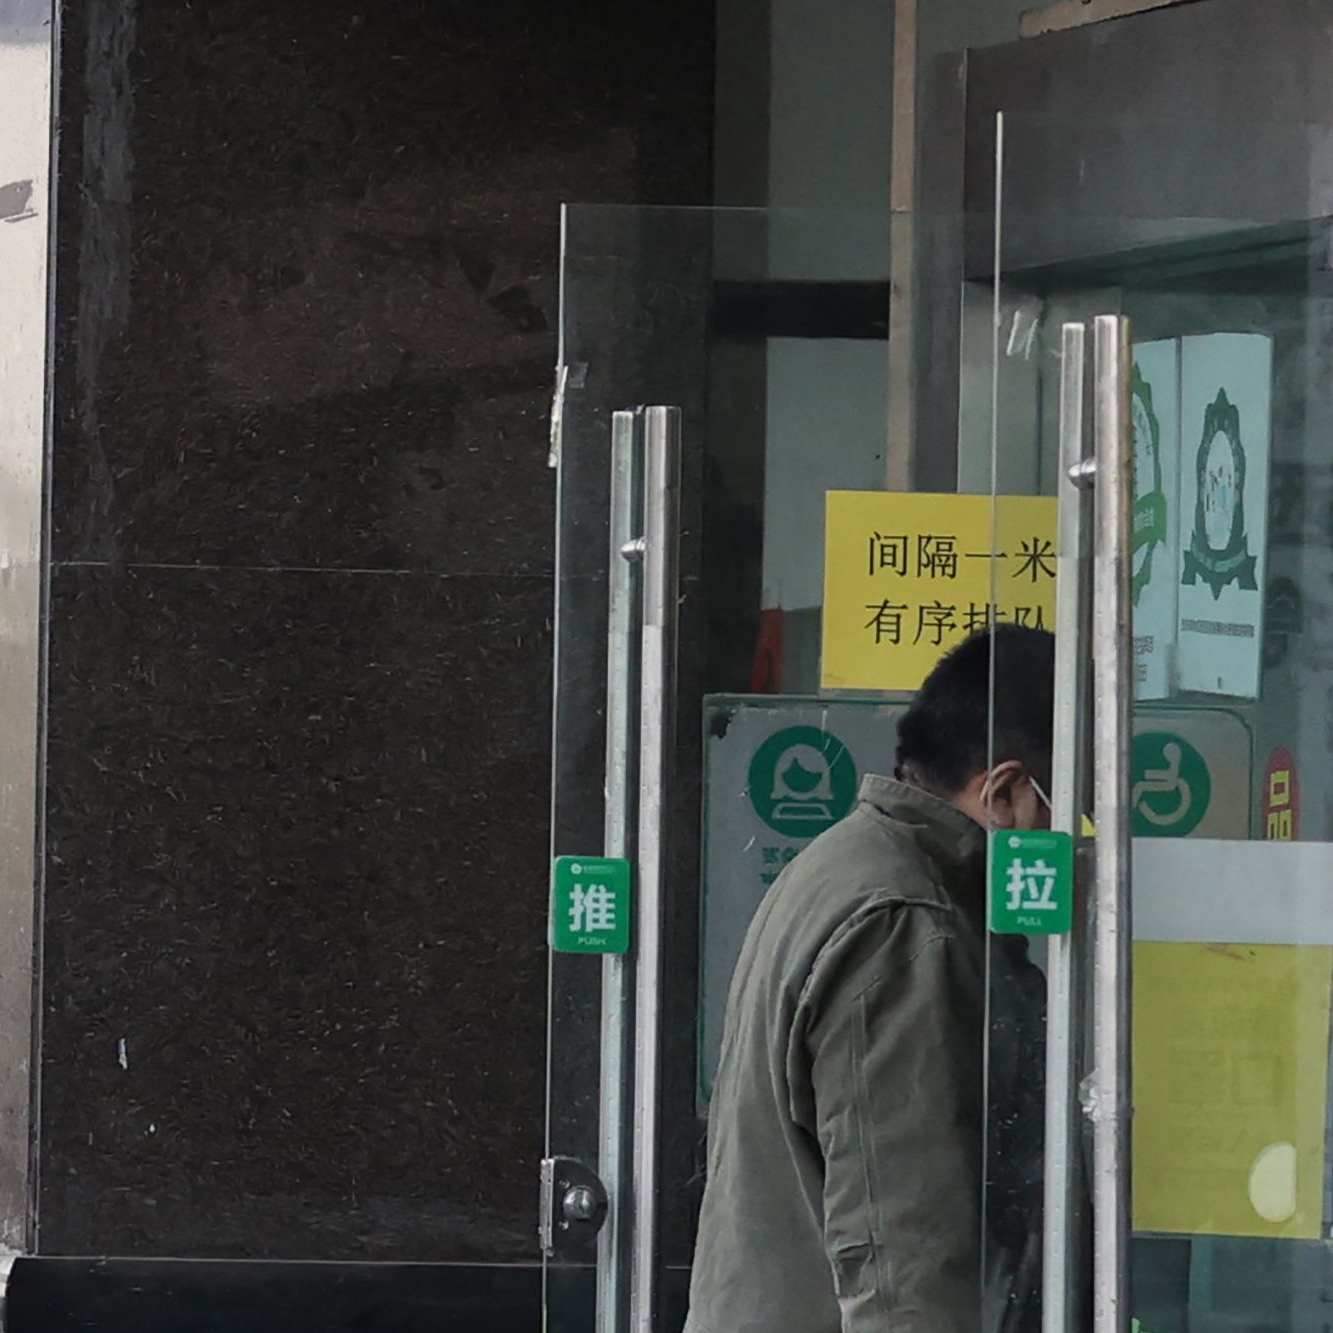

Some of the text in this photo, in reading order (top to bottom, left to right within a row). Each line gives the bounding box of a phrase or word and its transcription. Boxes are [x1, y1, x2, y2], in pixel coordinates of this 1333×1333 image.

[867, 531, 1058, 583] 间隔一米
[568, 883, 616, 932] 推
[1005, 857, 1058, 910] 拉
[577, 936, 606, 945] PUSH
